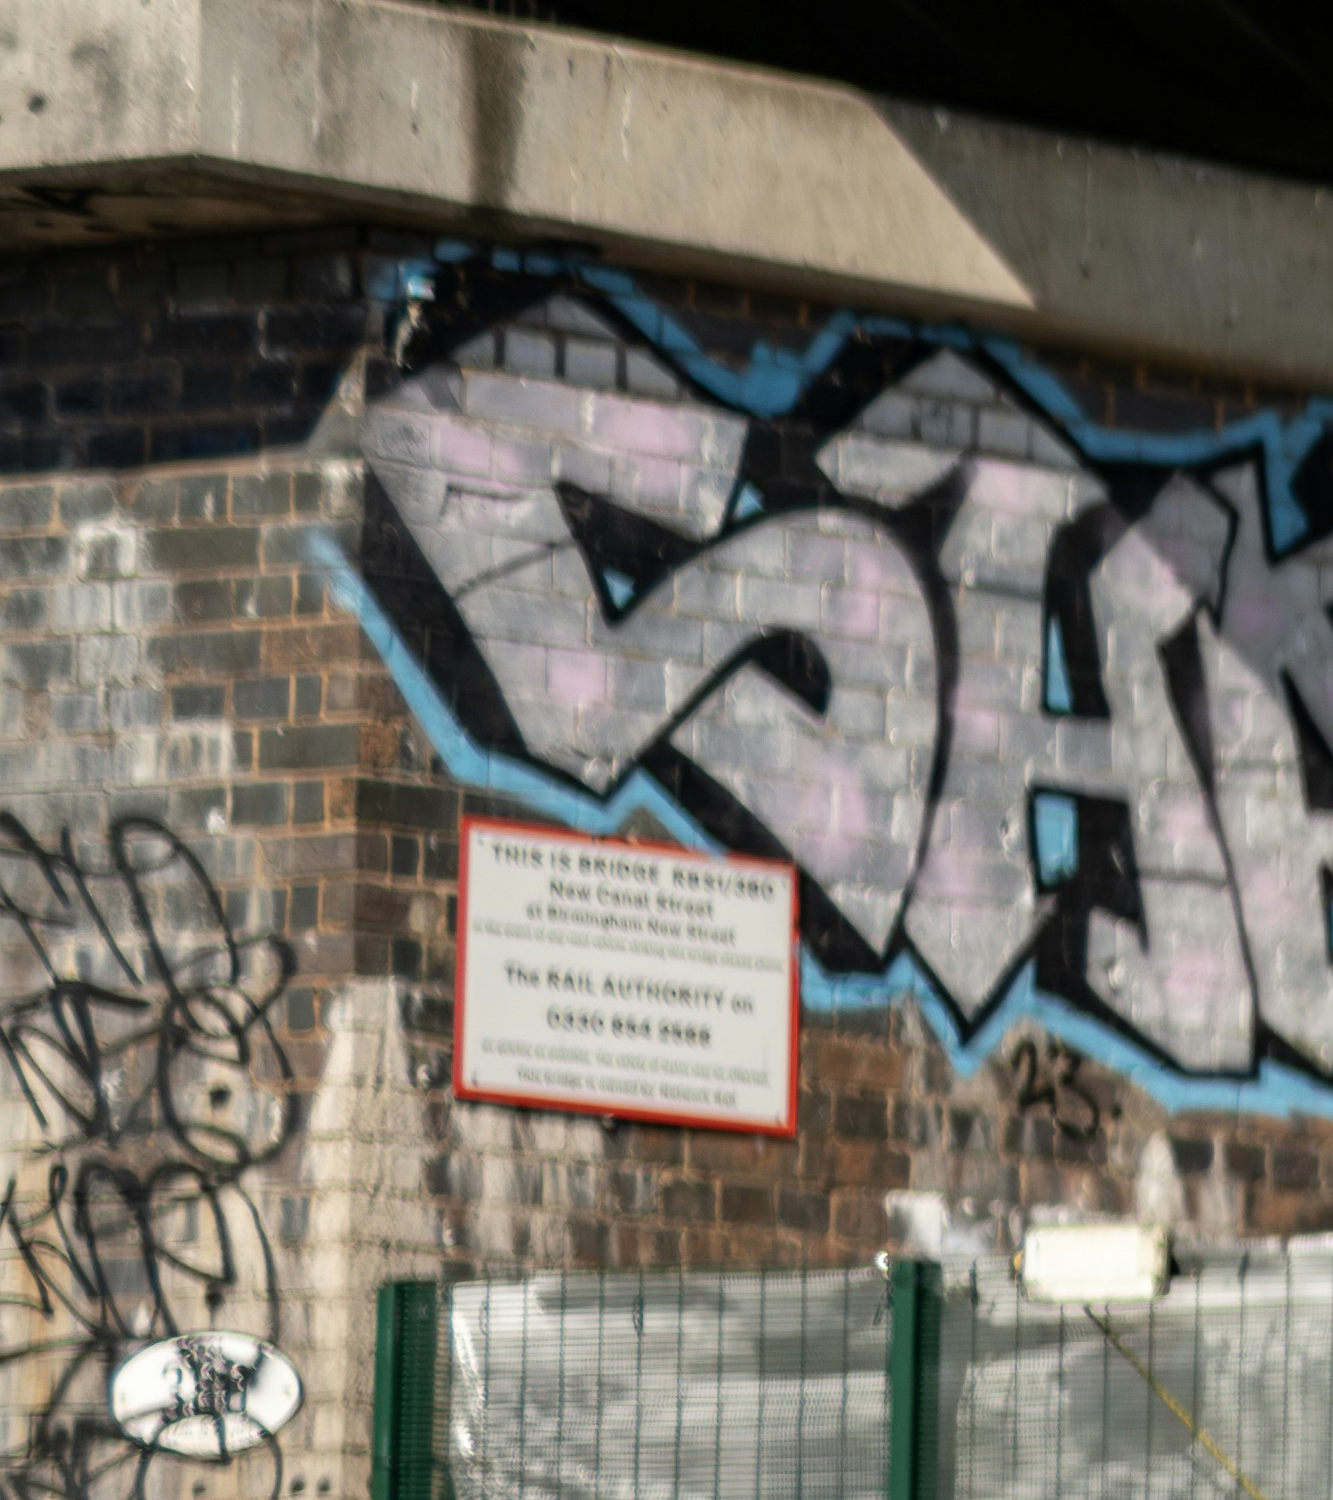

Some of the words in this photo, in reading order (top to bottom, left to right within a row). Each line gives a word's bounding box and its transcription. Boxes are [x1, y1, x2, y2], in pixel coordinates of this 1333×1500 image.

[492, 841, 543, 868] THIS
[550, 849, 571, 873] IS
[578, 853, 660, 886] BRIDGE
[525, 899, 543, 921] at
[647, 917, 682, 940] New
[549, 877, 591, 902] New
[596, 883, 649, 910] Canal
[655, 891, 715, 919] Street
[504, 959, 541, 990] The
[546, 966, 597, 998] RAIL
[602, 973, 725, 1015] AUTHORITY
[730, 990, 755, 1018] on
